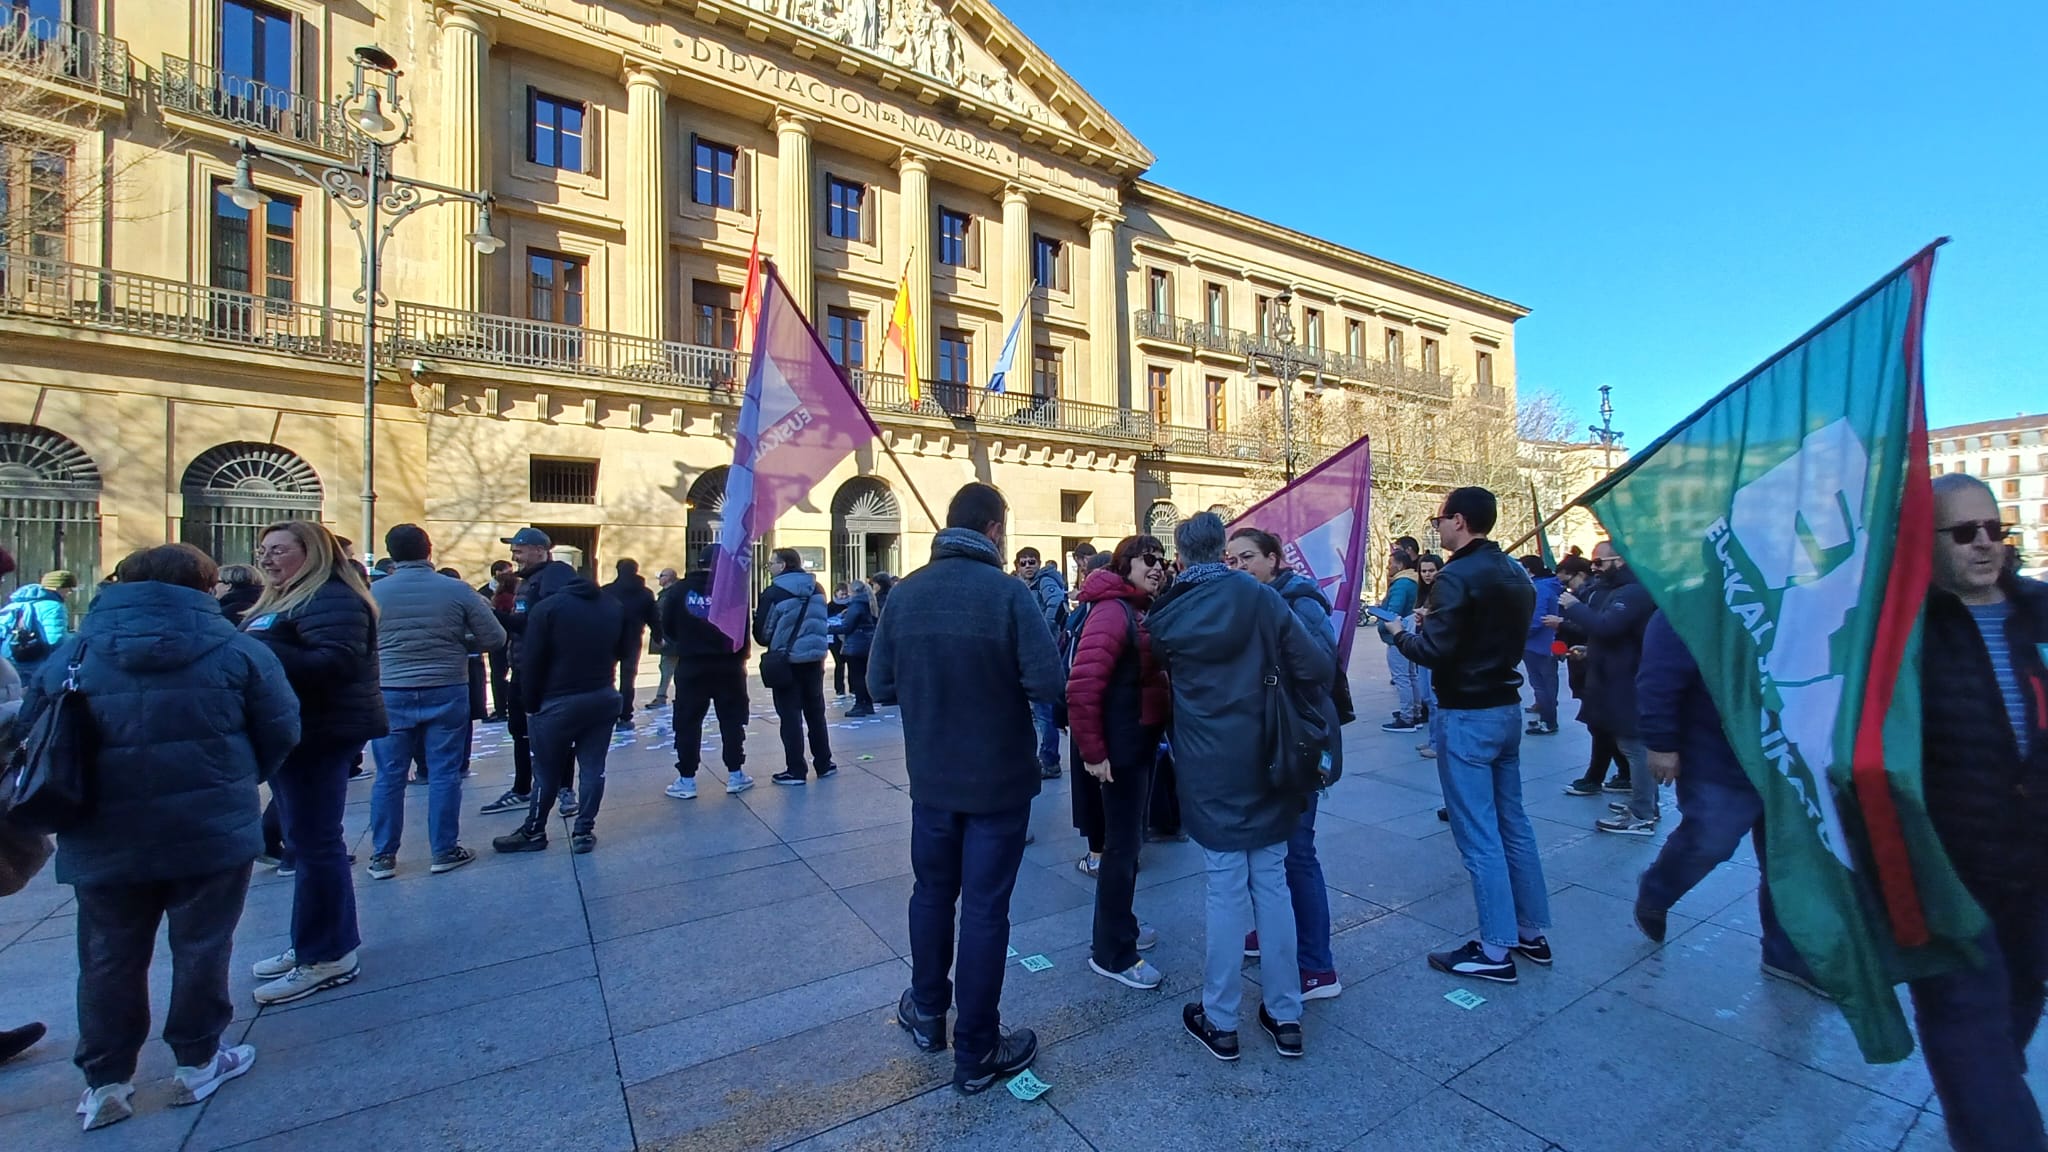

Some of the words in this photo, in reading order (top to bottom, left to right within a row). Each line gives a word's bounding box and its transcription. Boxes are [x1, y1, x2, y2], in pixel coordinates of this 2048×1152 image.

[882, 110, 897, 125] DE
[900, 114, 1001, 165] NAVARRA
[688, 596, 713, 606] NAS
